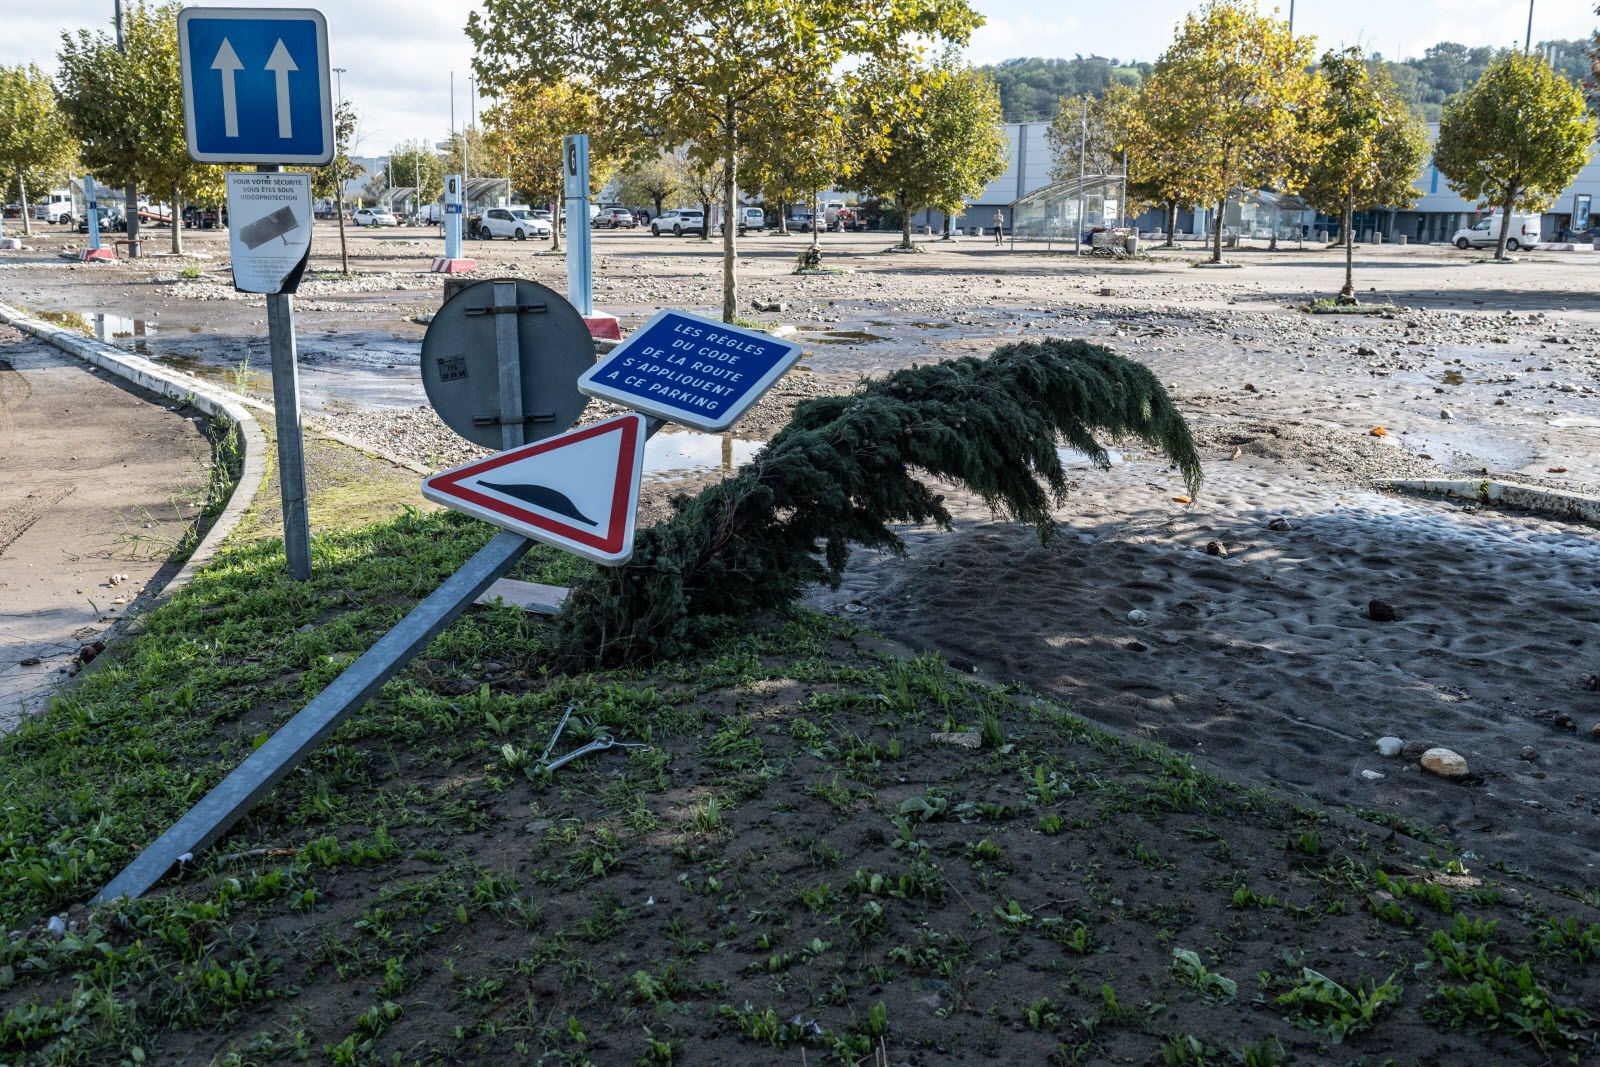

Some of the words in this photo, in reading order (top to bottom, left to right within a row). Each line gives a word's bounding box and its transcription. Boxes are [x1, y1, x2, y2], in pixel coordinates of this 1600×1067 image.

[672, 339, 695, 350] DU
[698, 347, 740, 365] CODE
[674, 324, 702, 337] LES
[706, 333, 764, 355] RÈGLES
[622, 358, 734, 396] S'APPLIQUENT
[642, 346, 664, 358] DE
[666, 354, 686, 366] LA
[690, 361, 743, 382] ROUTE
[606, 371, 620, 380] A
[624, 376, 646, 388] CE
[648, 383, 718, 410] PARKING
